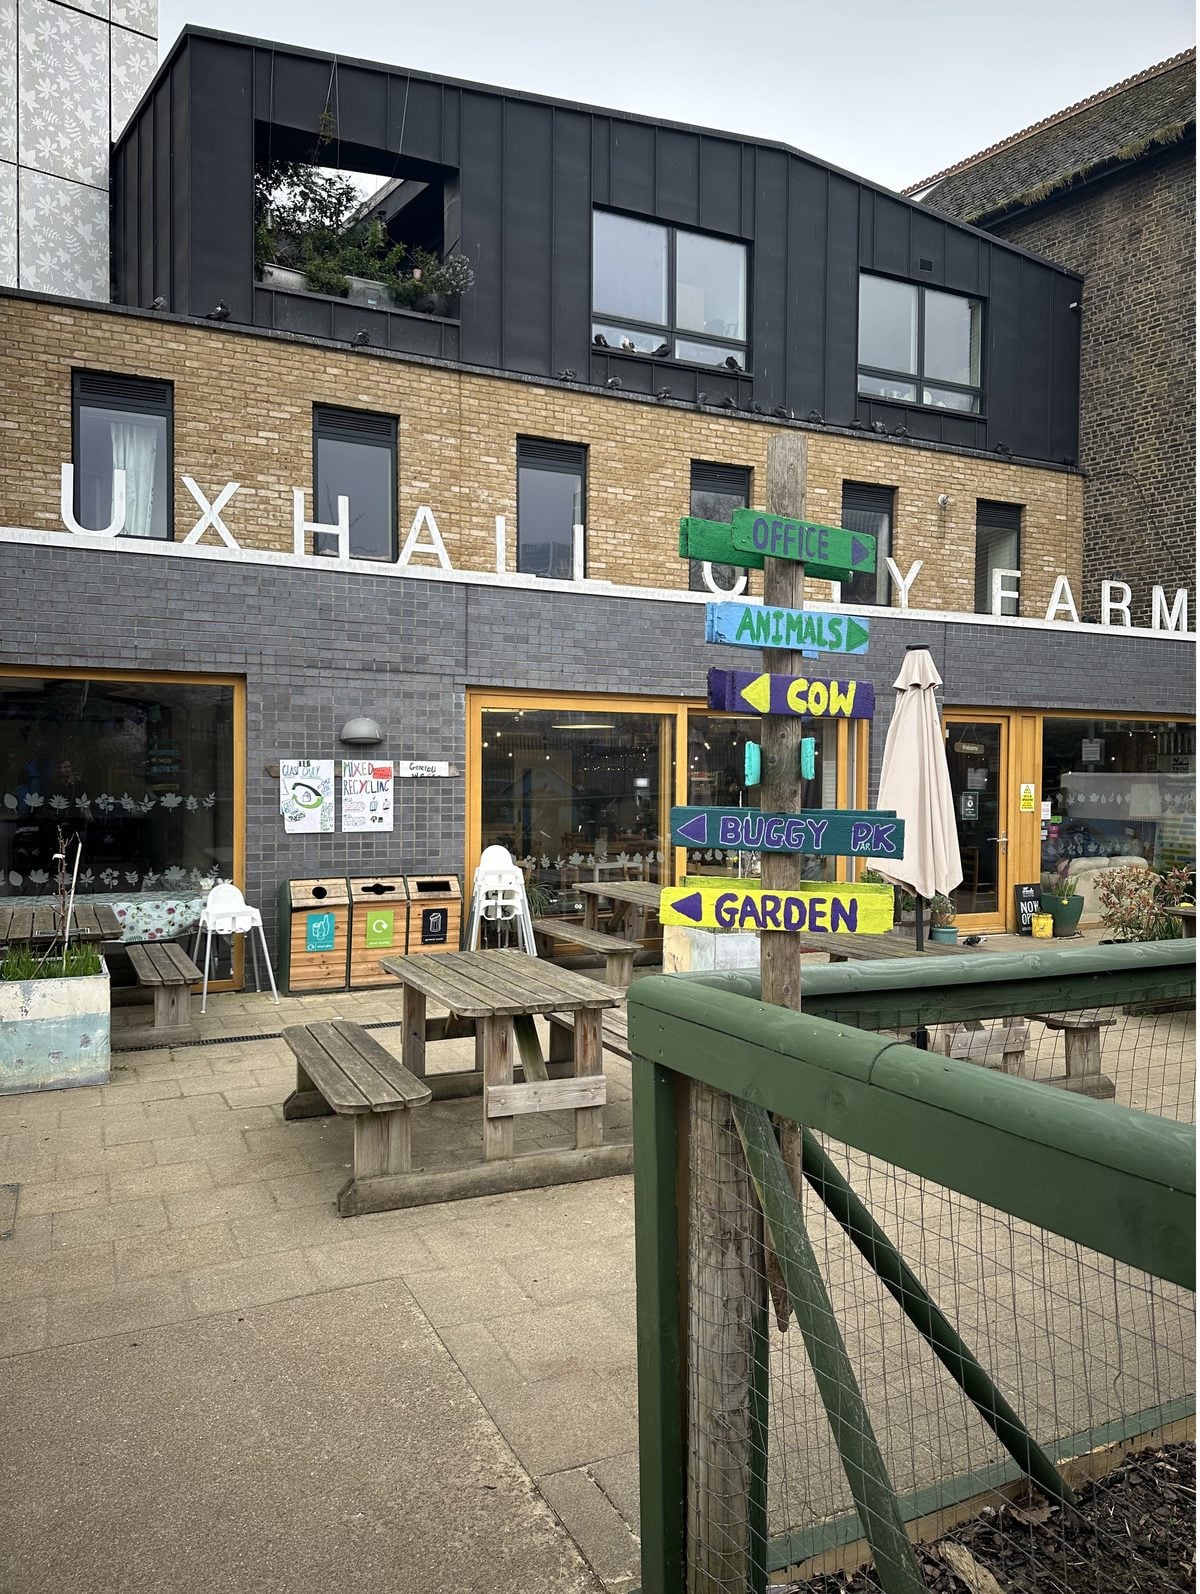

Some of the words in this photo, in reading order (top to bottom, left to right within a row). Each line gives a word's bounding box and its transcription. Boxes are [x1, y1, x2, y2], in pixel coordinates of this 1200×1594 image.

[752, 518, 829, 560] OFFICE
[991, 568, 1188, 632] FARM
[735, 607, 843, 650] ANIMALS
[787, 678, 857, 716] COW
[344, 761, 374, 777] MIXED
[719, 815, 828, 850] BUGGY
[715, 893, 858, 933] GARDEN
